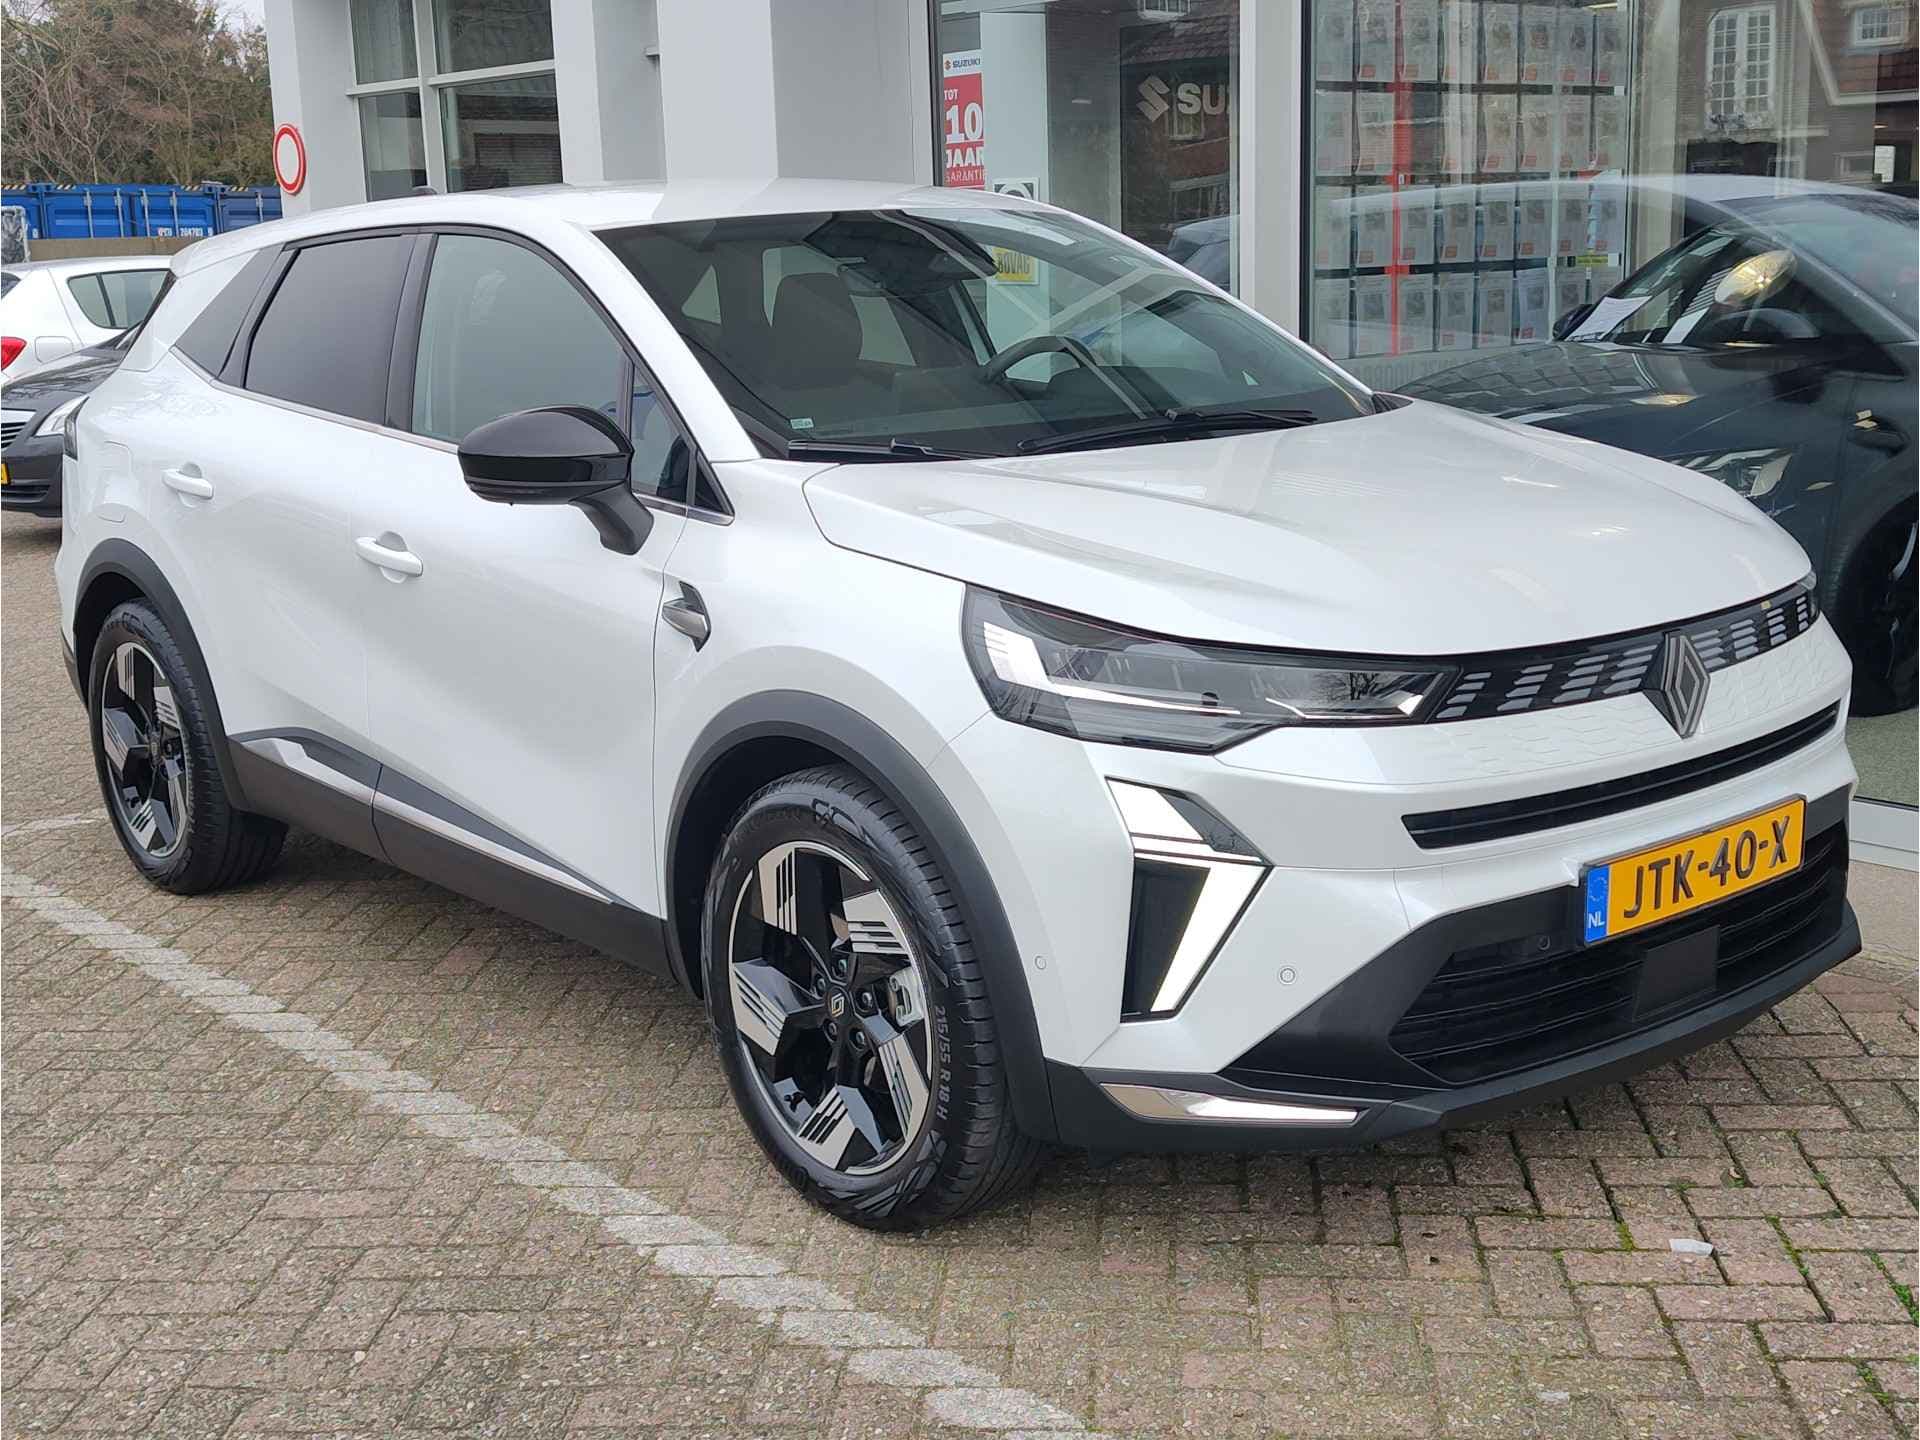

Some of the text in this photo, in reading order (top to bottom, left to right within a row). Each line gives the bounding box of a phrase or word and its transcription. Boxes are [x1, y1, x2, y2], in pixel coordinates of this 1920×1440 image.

[952, 58, 981, 68] SUZUKI
[944, 88, 959, 100] TOT
[1177, 83, 1229, 115] SU
[946, 102, 984, 144] 10
[1623, 815, 1791, 919] JTK-40-X
[1588, 911, 1605, 929] NL
[935, 1005, 952, 1121] 215/55 R 18 H
